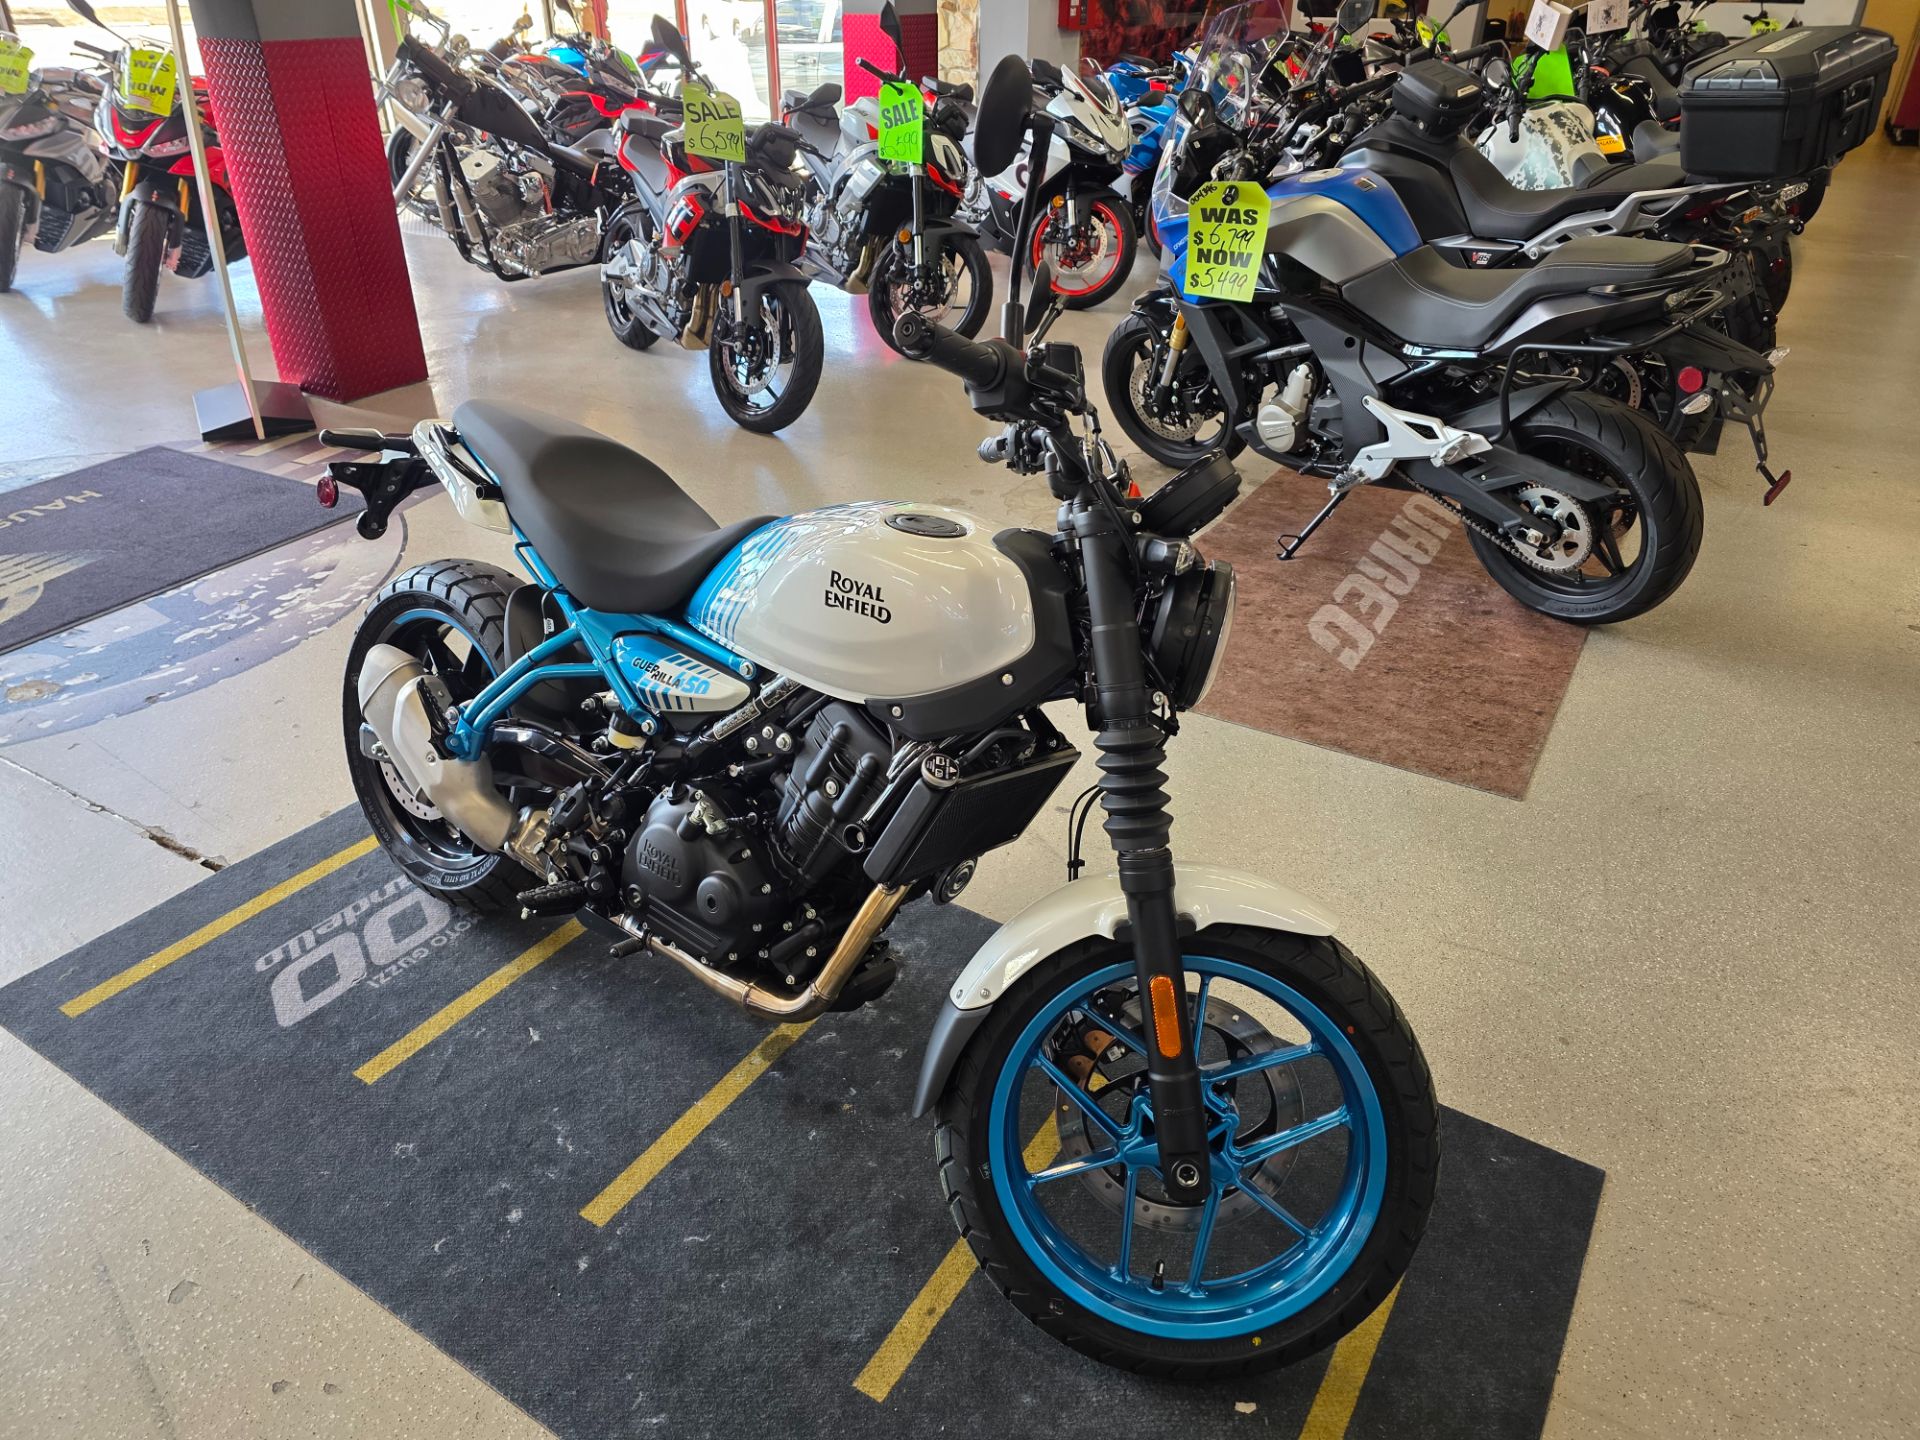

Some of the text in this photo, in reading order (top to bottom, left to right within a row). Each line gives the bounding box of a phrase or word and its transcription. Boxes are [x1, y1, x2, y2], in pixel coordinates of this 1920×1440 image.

[686, 101, 740, 123] SALE
[881, 98, 919, 129] SALE
[1200, 207, 1258, 226] WAS
[1196, 247, 1253, 268] NOW
[829, 569, 885, 603] ROYAL
[824, 589, 892, 624] ENFIELD
[643, 838, 681, 869] ROYAL
[638, 852, 683, 888] ENFIELD
[366, 947, 430, 989] GUZZI
